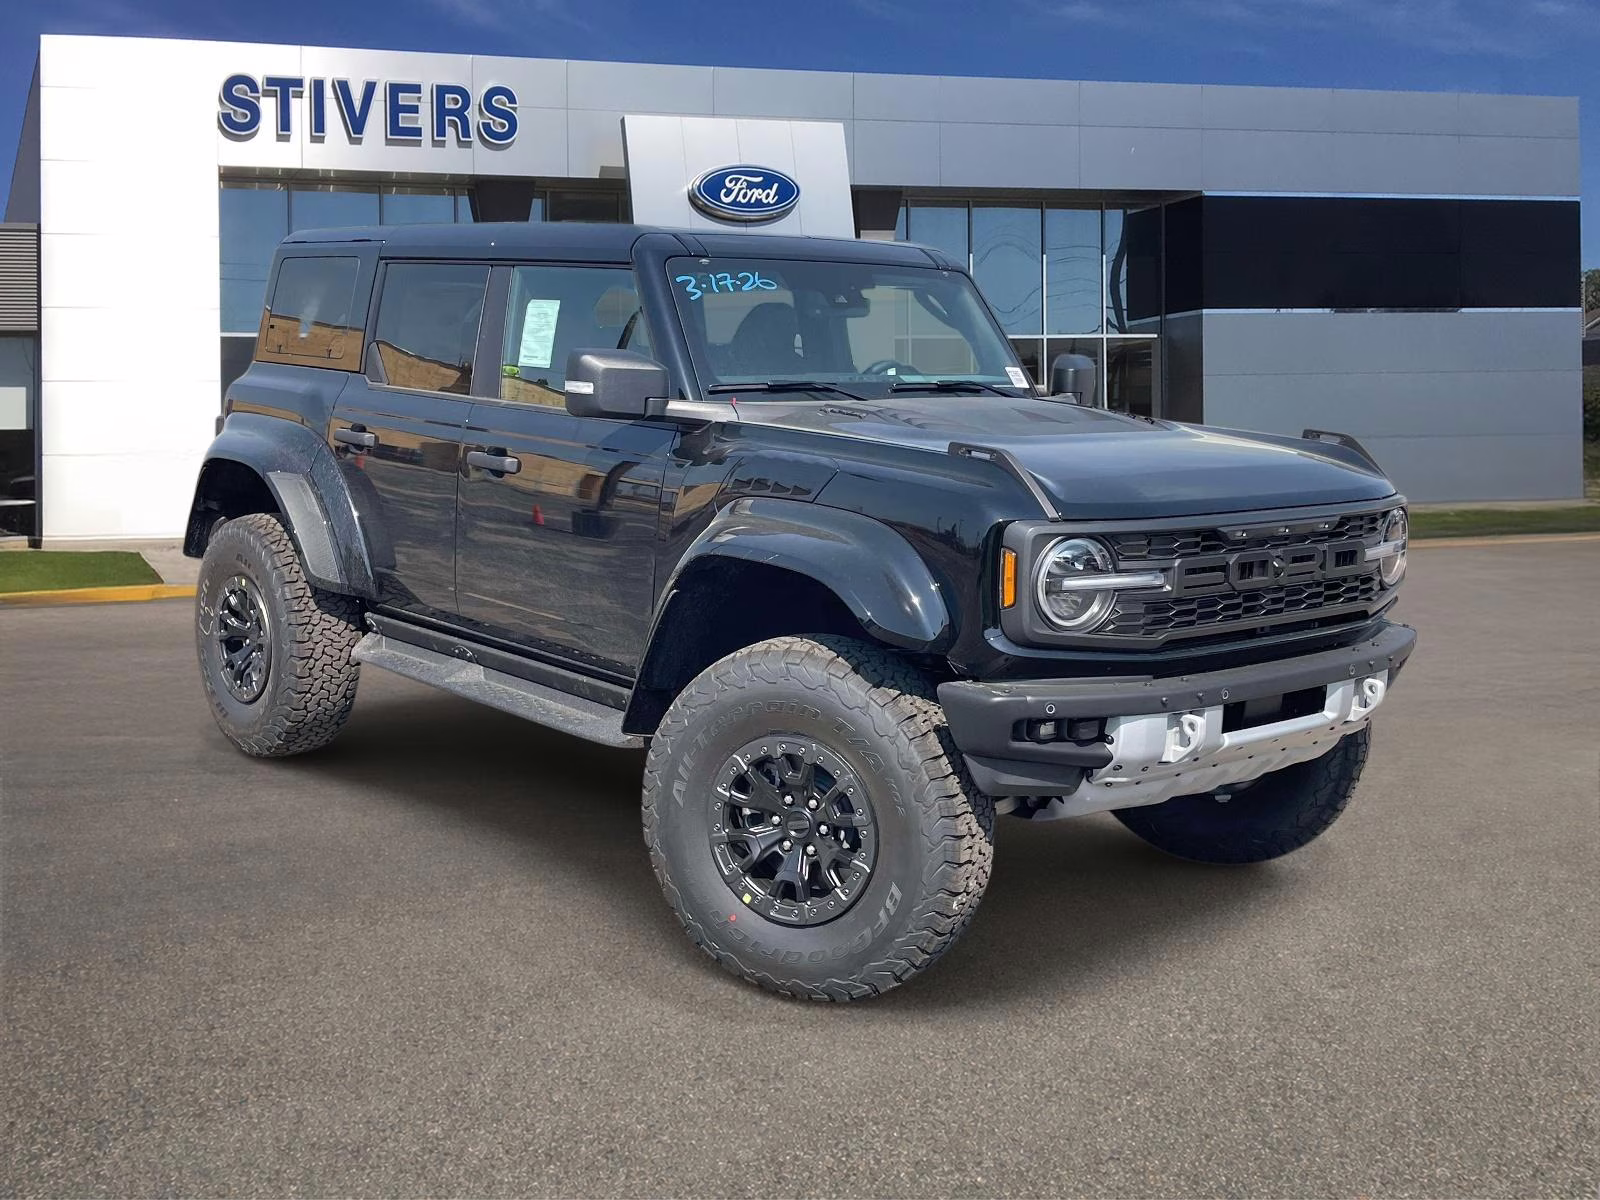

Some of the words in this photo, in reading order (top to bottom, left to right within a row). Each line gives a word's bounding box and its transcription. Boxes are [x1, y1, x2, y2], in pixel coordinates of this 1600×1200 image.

[217, 73, 519, 149] STIVERS
[720, 174, 779, 204] Ford
[1174, 540, 1366, 599] FORD
